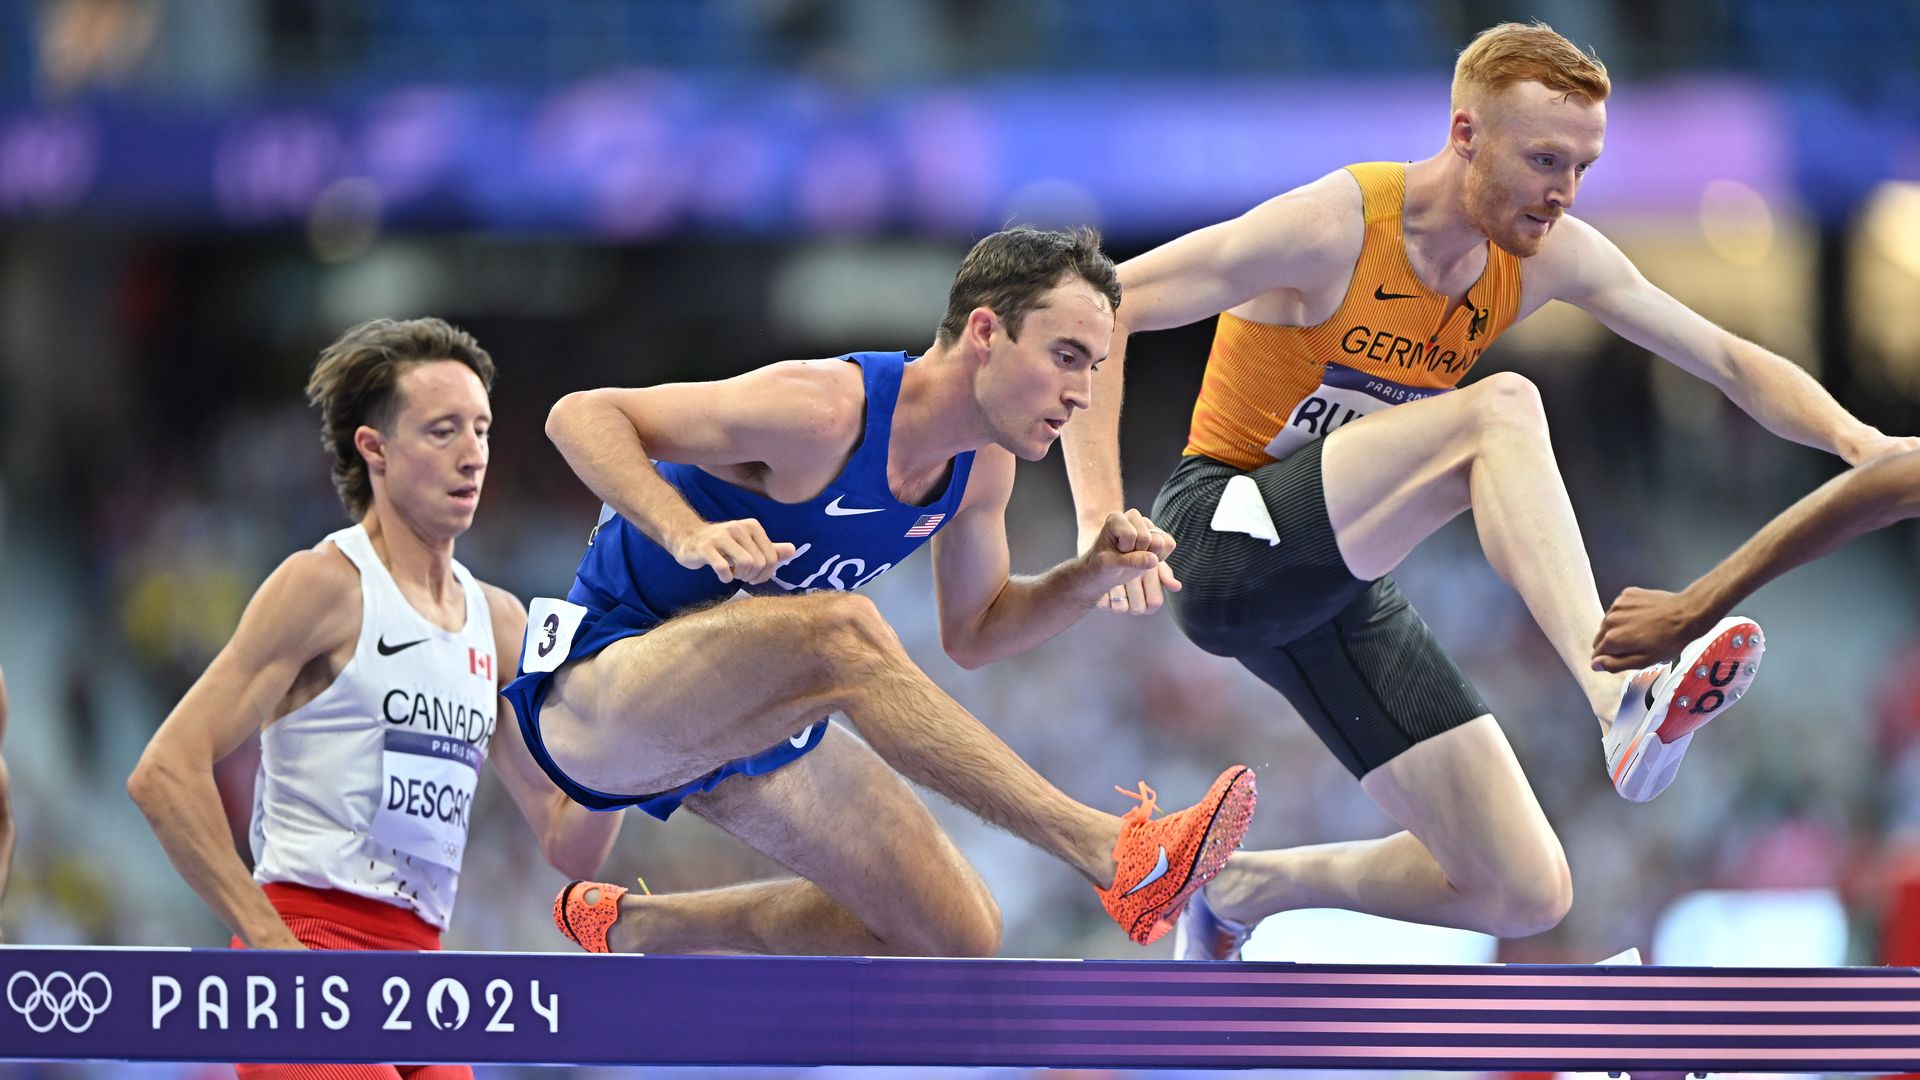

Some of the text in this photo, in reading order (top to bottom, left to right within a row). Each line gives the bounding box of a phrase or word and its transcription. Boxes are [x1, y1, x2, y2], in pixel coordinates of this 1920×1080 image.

[1341, 326, 1482, 374] GERMAN
[1365, 381, 1405, 401] PARIS
[1292, 396, 1365, 437] RU
[538, 613, 560, 658] 3
[431, 739, 465, 758] PARIS
[381, 976, 559, 1034] 2024
